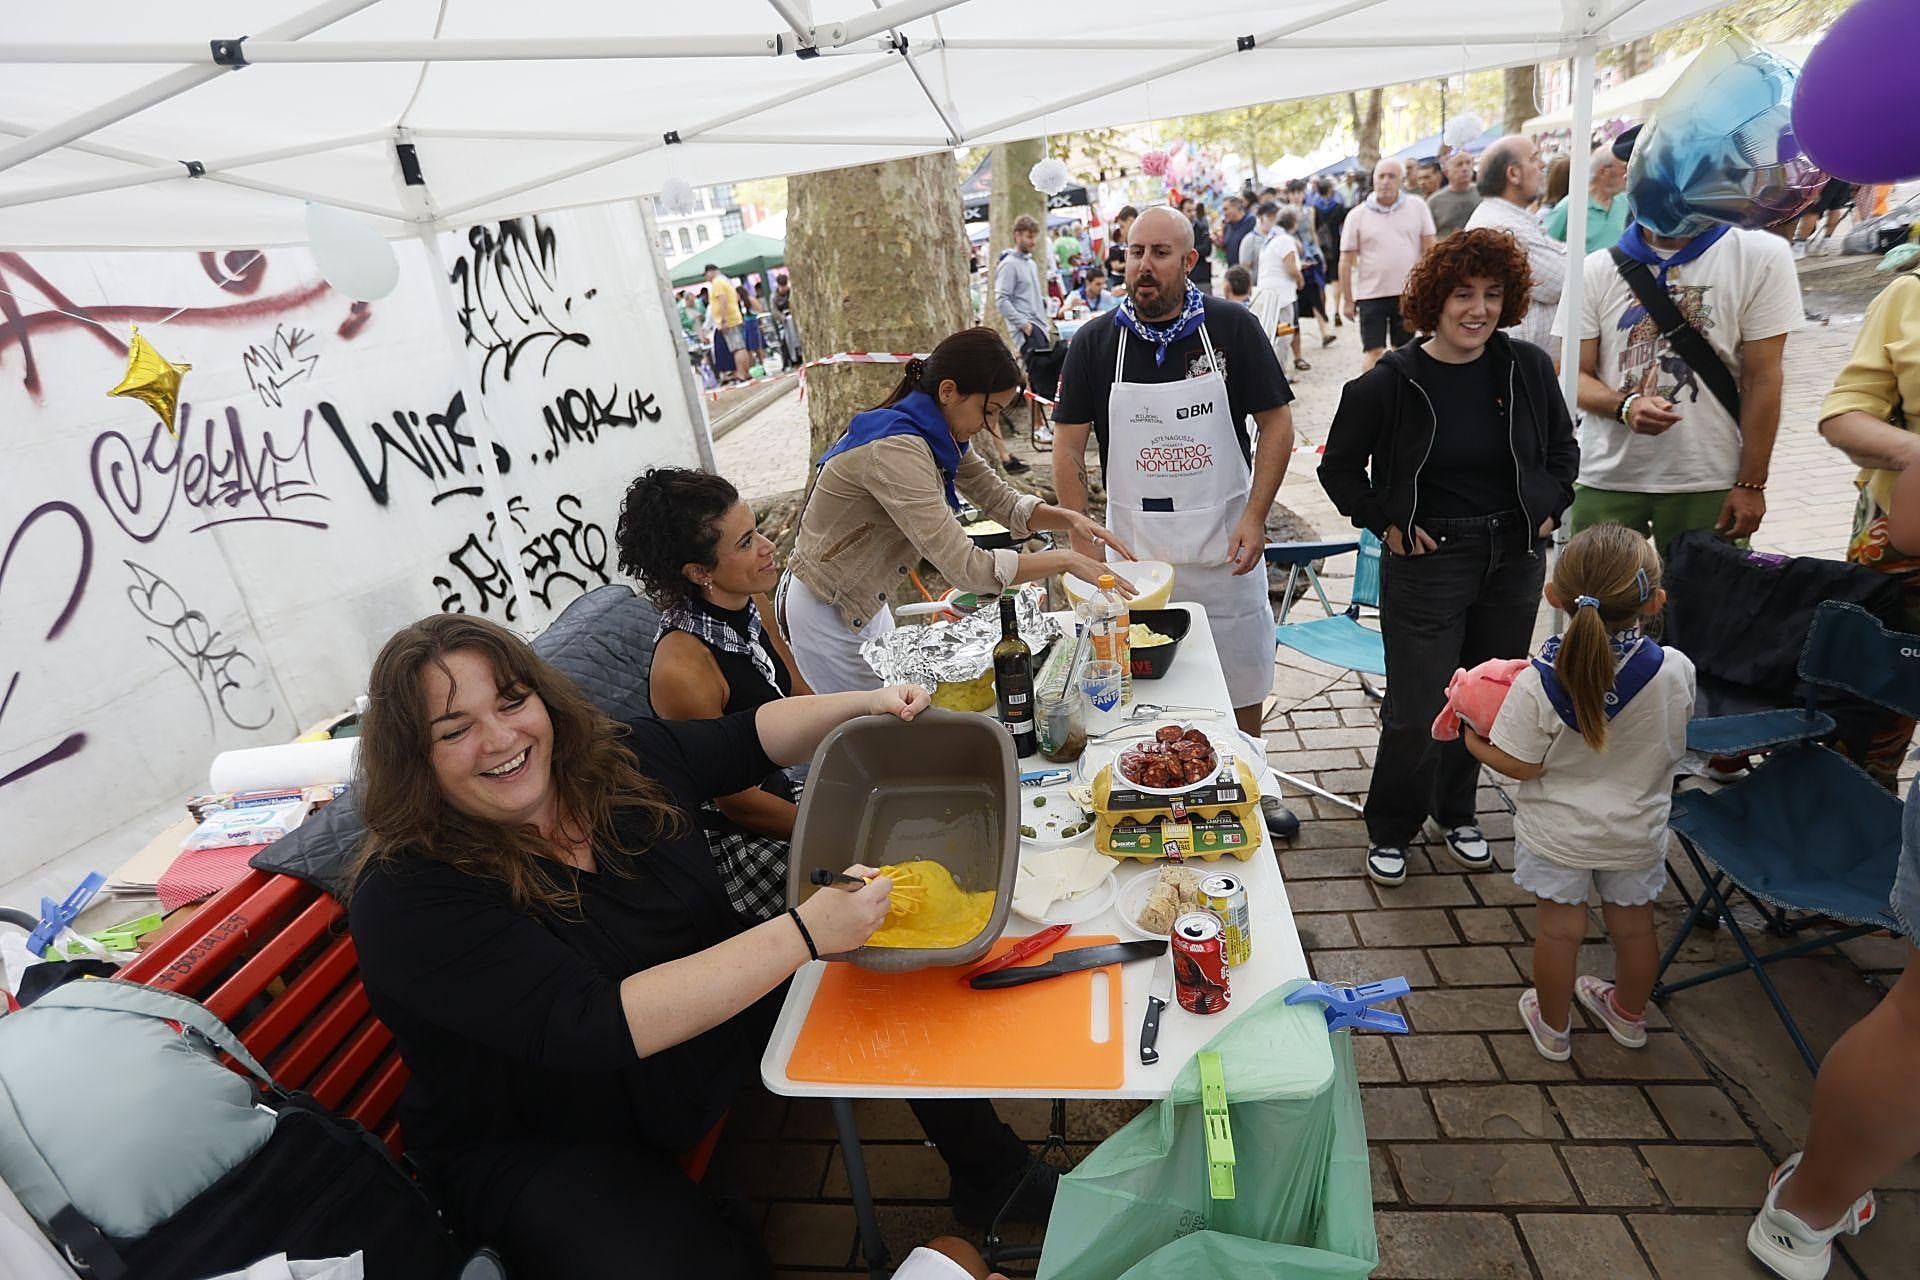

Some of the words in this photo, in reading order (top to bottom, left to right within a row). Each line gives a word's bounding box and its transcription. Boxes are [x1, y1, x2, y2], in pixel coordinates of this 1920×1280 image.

[1190, 402, 1213, 418] BM
[1140, 444, 1212, 460] GASTRO-
[1136, 455, 1213, 472] NOMIKOA
